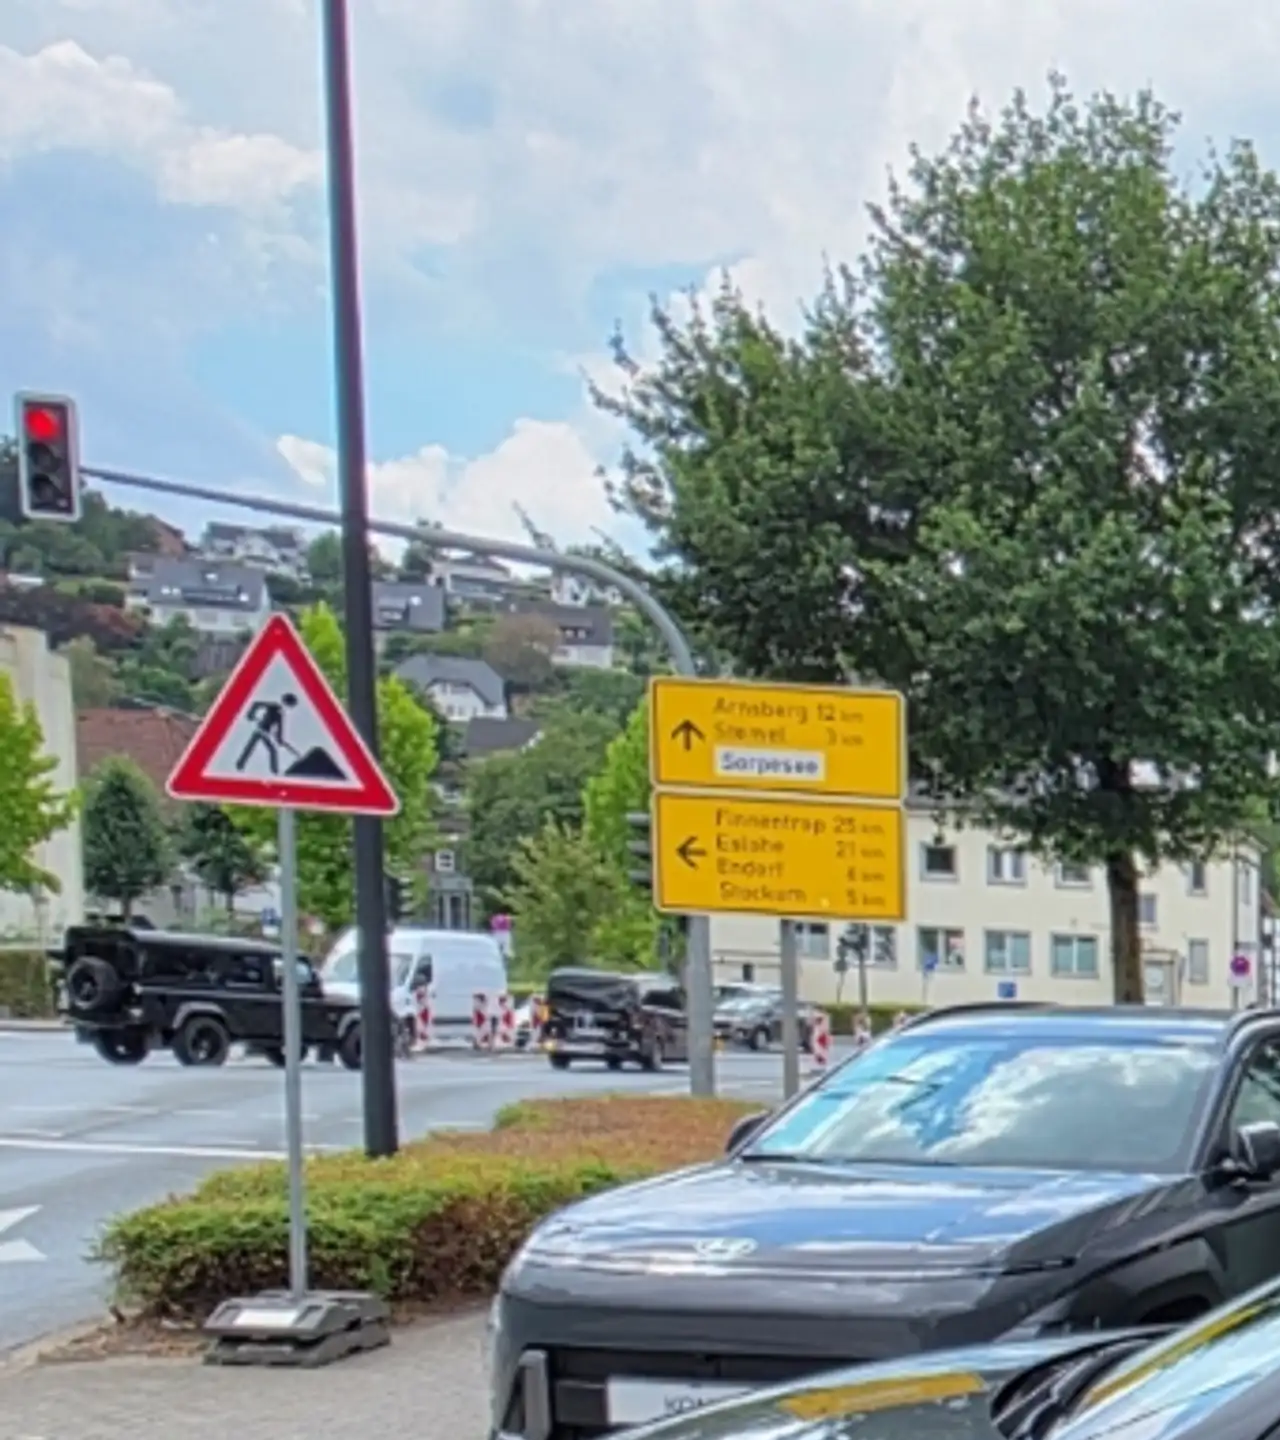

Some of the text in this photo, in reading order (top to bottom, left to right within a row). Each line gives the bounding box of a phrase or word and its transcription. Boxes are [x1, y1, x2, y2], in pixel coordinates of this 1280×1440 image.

[713, 697, 809, 724] Arnsberg
[817, 703, 835, 722] 12
[721, 751, 819, 775] Sorpesee
